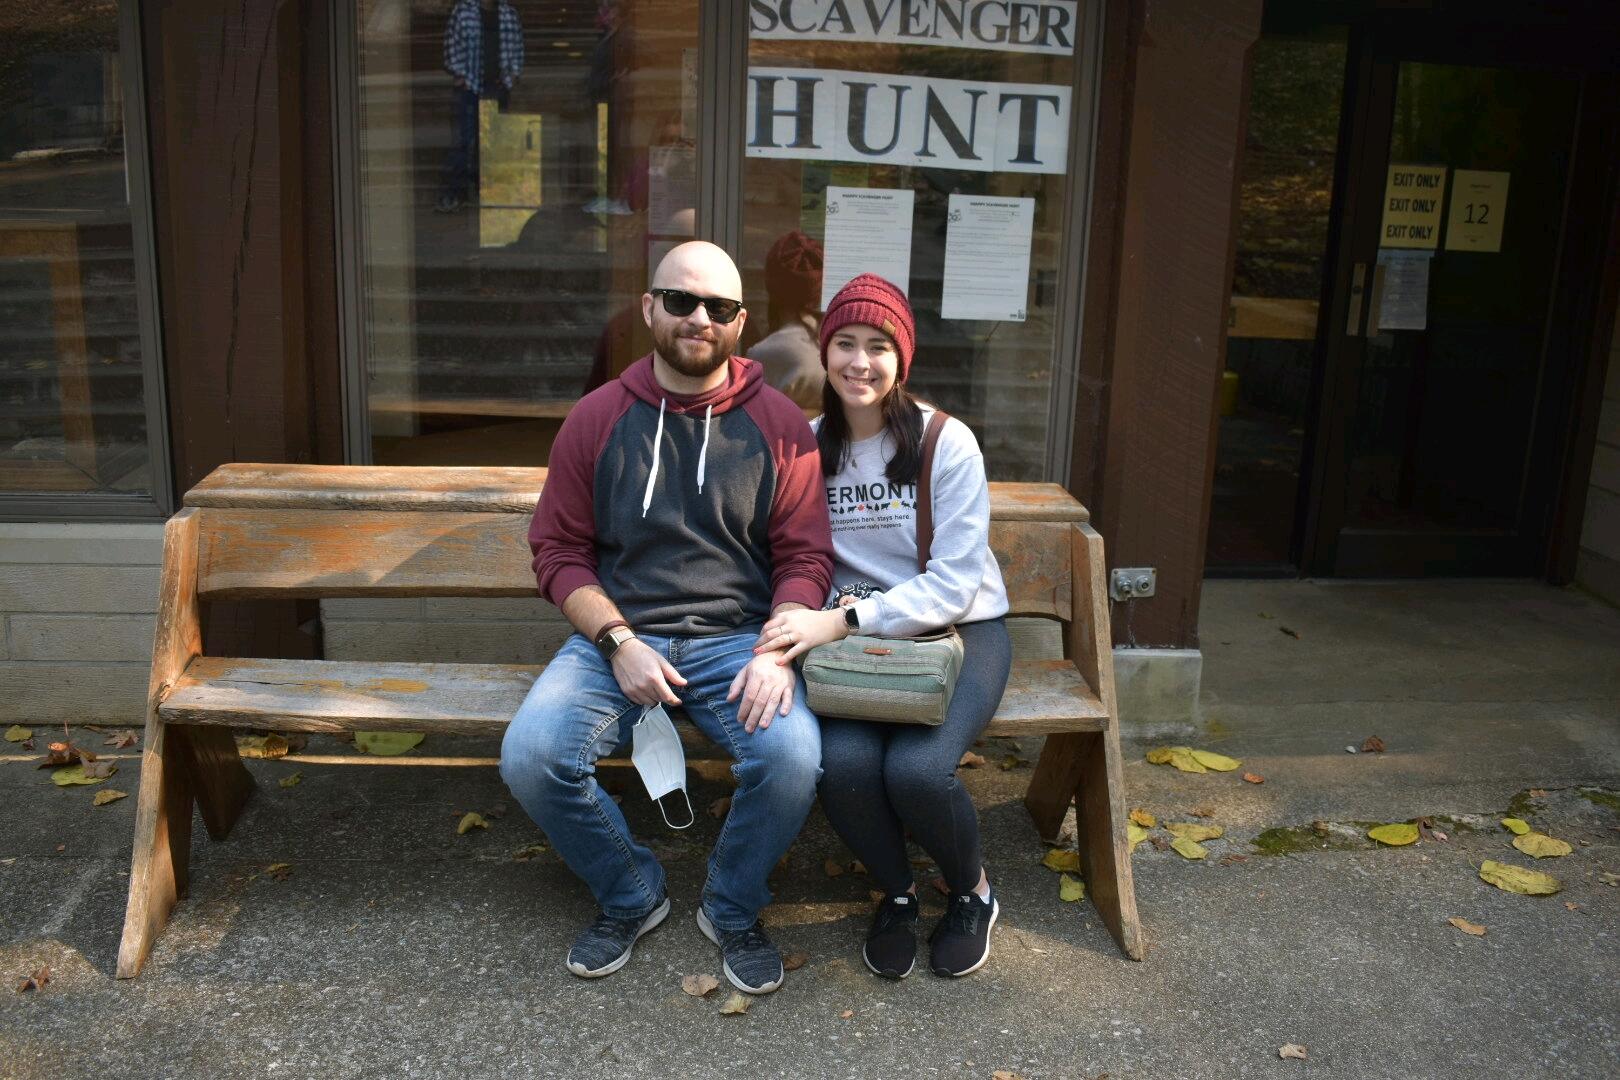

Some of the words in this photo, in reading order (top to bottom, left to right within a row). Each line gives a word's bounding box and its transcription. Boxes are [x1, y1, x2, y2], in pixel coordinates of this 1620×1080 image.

[749, 0, 1073, 48] SCAVENGER
[747, 75, 1061, 165] HUNT
[1393, 172, 1416, 187] EXIT
[1416, 174, 1440, 188] ONLY
[1389, 198, 1411, 212] EXIT
[1412, 199, 1437, 214] ONLY
[1463, 202, 1490, 225] 12
[1386, 224, 1409, 238] EXIT
[1409, 225, 1434, 240] ONLY
[826, 482, 916, 505] ERMONT
